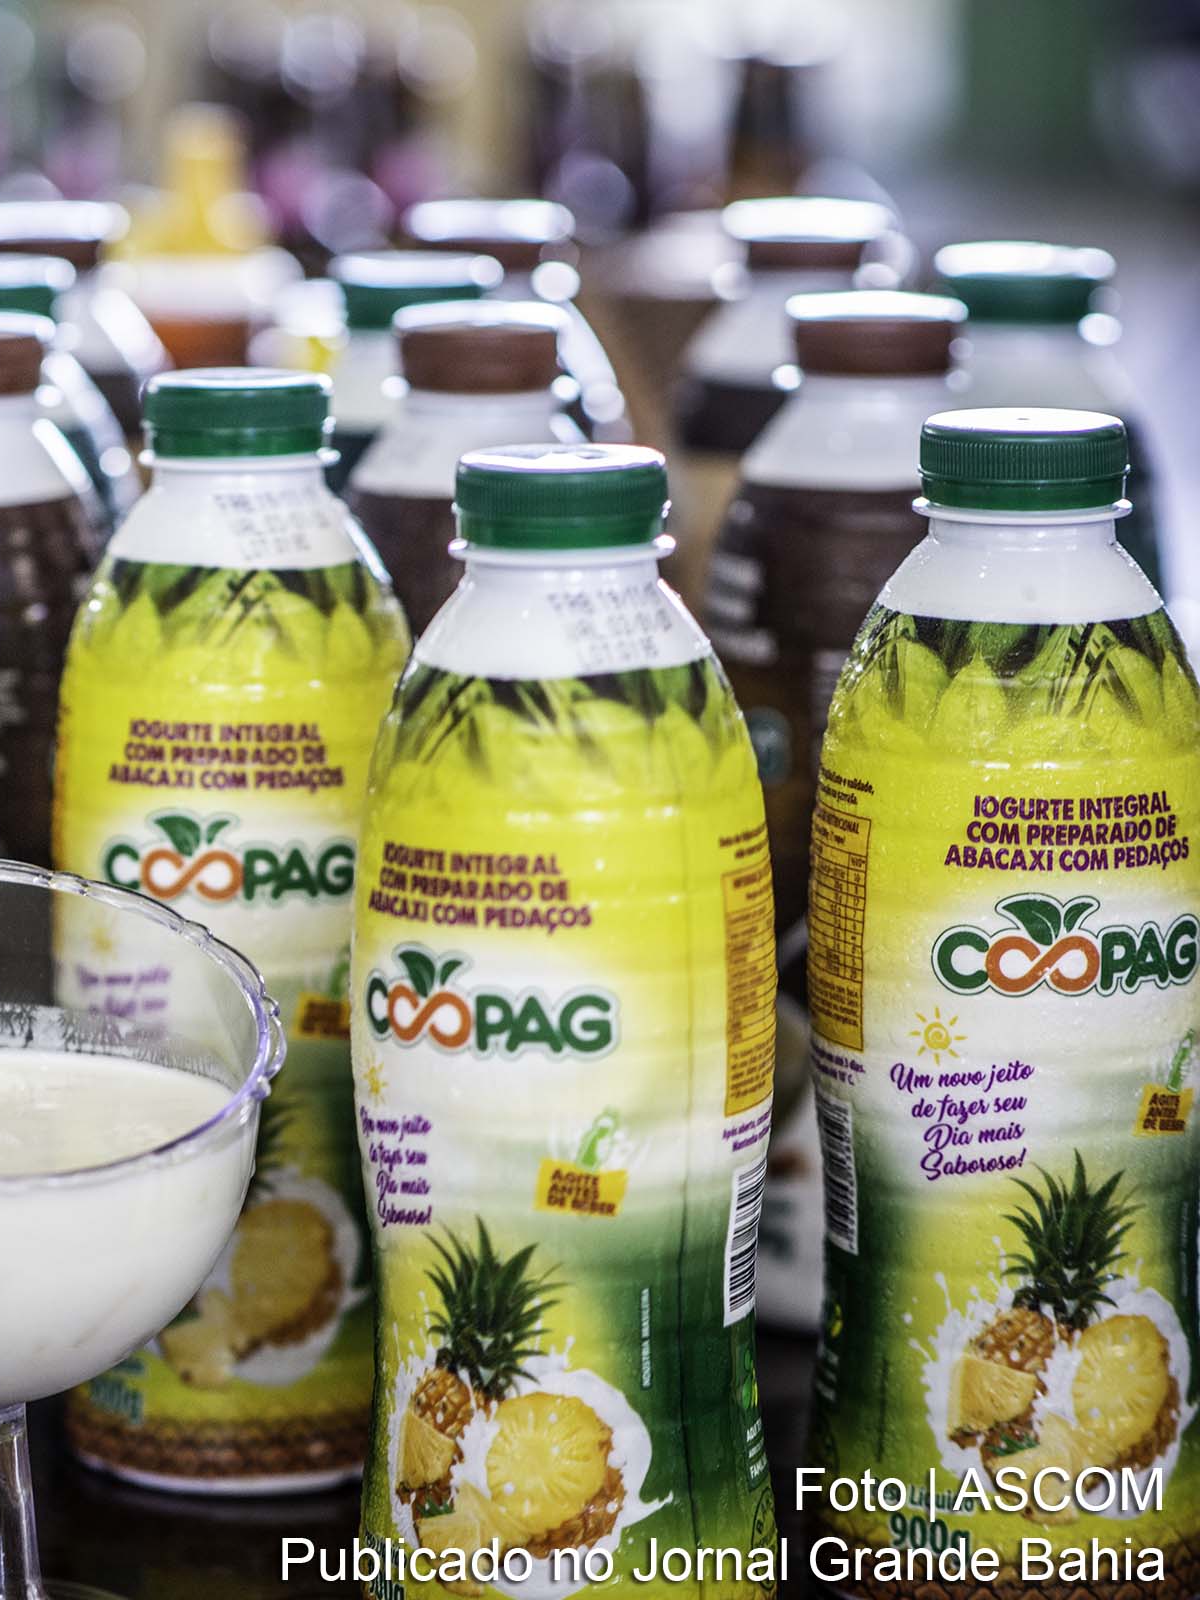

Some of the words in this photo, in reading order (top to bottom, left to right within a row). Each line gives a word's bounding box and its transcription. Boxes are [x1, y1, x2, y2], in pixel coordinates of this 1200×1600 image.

[130, 719, 212, 742] IOGURTE
[220, 722, 320, 742] INTEGRAL
[125, 743, 165, 762] COM
[172, 745, 297, 765] PREPARADO
[303, 745, 327, 765] DE
[108, 763, 193, 787] ABACAXI
[201, 771, 247, 789] COM
[974, 795, 1074, 820] IOGURTE
[1079, 790, 1171, 820] INTEGRAL
[967, 821, 1020, 844] COM
[1026, 819, 1151, 846] PREPARADO
[1155, 814, 1177, 839] DE
[384, 841, 445, 873] IOGURTE
[452, 852, 561, 876] INTEGRAL
[944, 845, 1053, 872] ABACAXI
[1058, 849, 1109, 872] COM
[1114, 837, 1189, 870] PEDAÇOS
[411, 873, 532, 902] PREPARADO
[540, 880, 569, 901] DE
[433, 903, 478, 926] COM
[484, 905, 592, 936] PEDAÇOS
[937, 920, 1197, 993] COOPAG
[367, 977, 612, 1053] COOPAG
[890, 1062, 933, 1094] Um
[938, 1071, 986, 1088] novo
[983, 1060, 1035, 1093] jeito
[911, 1098, 937, 1118] de
[936, 1093, 990, 1125] fazer
[993, 1095, 1028, 1113] seu
[923, 1123, 973, 1150] Dia
[978, 1121, 1026, 1143] mais
[920, 1147, 1028, 1181] Saboroso!
